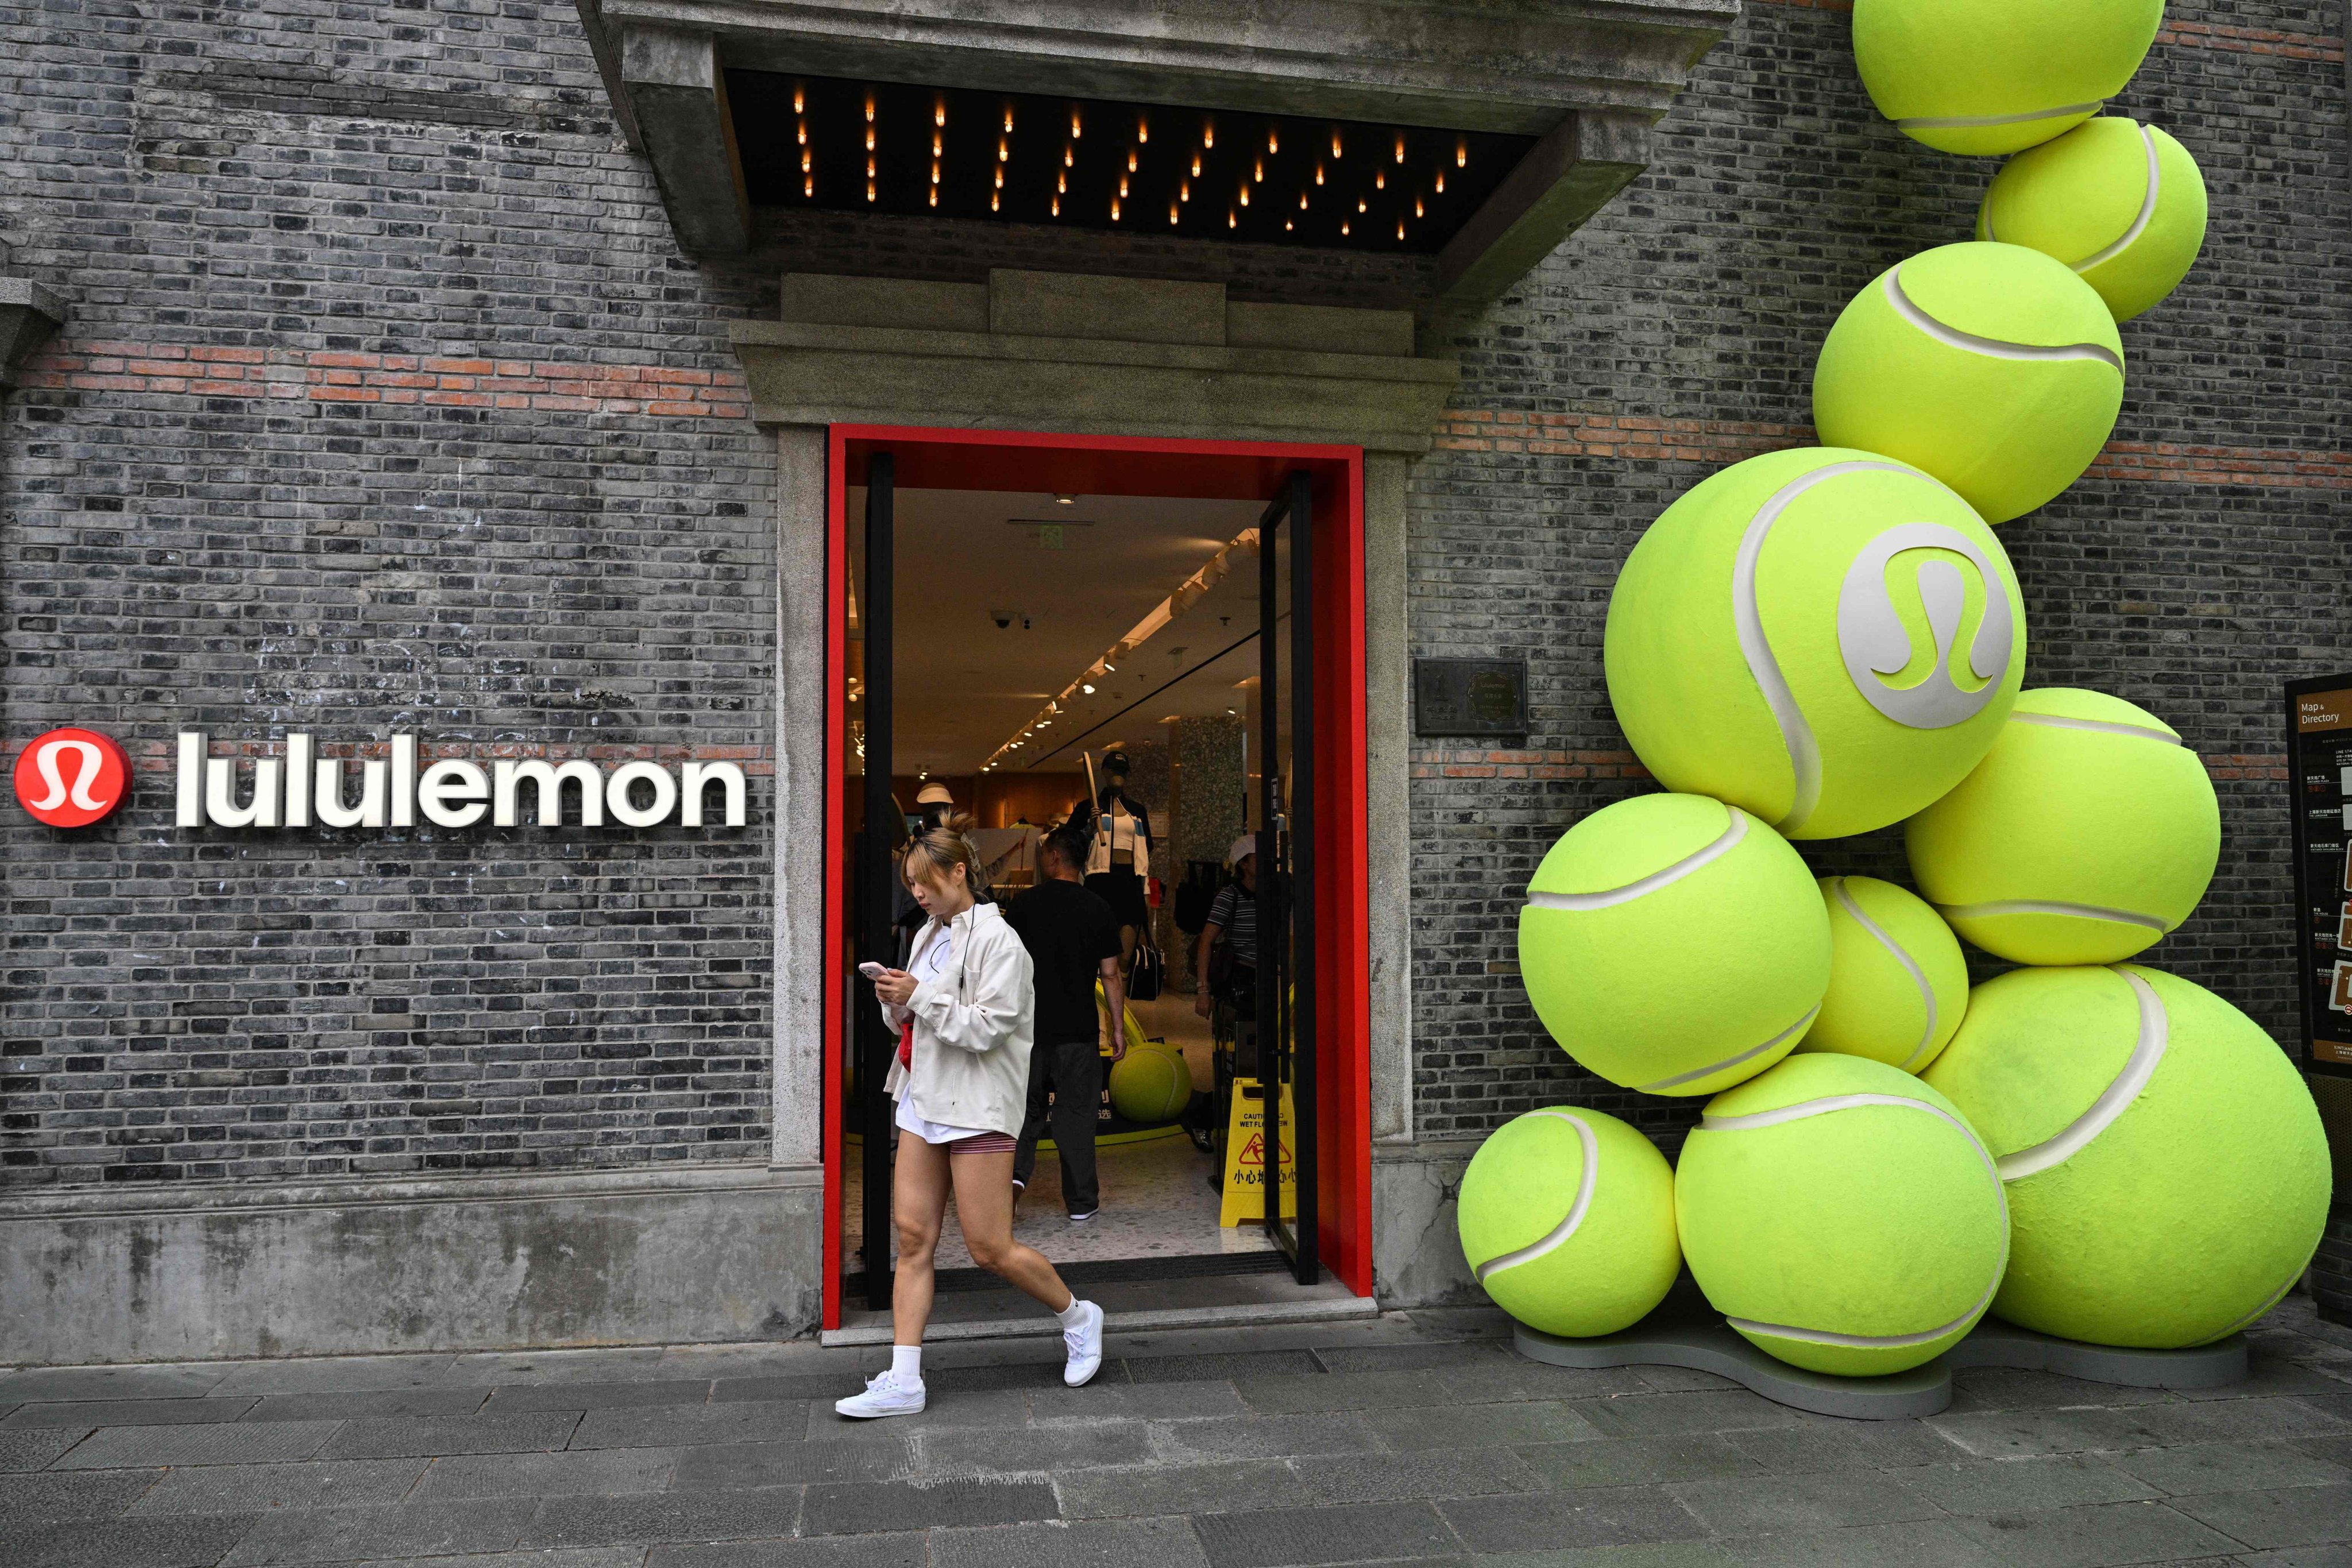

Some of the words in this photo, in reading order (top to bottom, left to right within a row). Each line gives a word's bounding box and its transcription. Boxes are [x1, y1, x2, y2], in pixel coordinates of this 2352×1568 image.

[2301, 703, 2319, 713] Map
[2302, 714, 2339, 724] Directory
[176, 732, 746, 827] lululemon
[1234, 1169, 1264, 1185] 小心地
